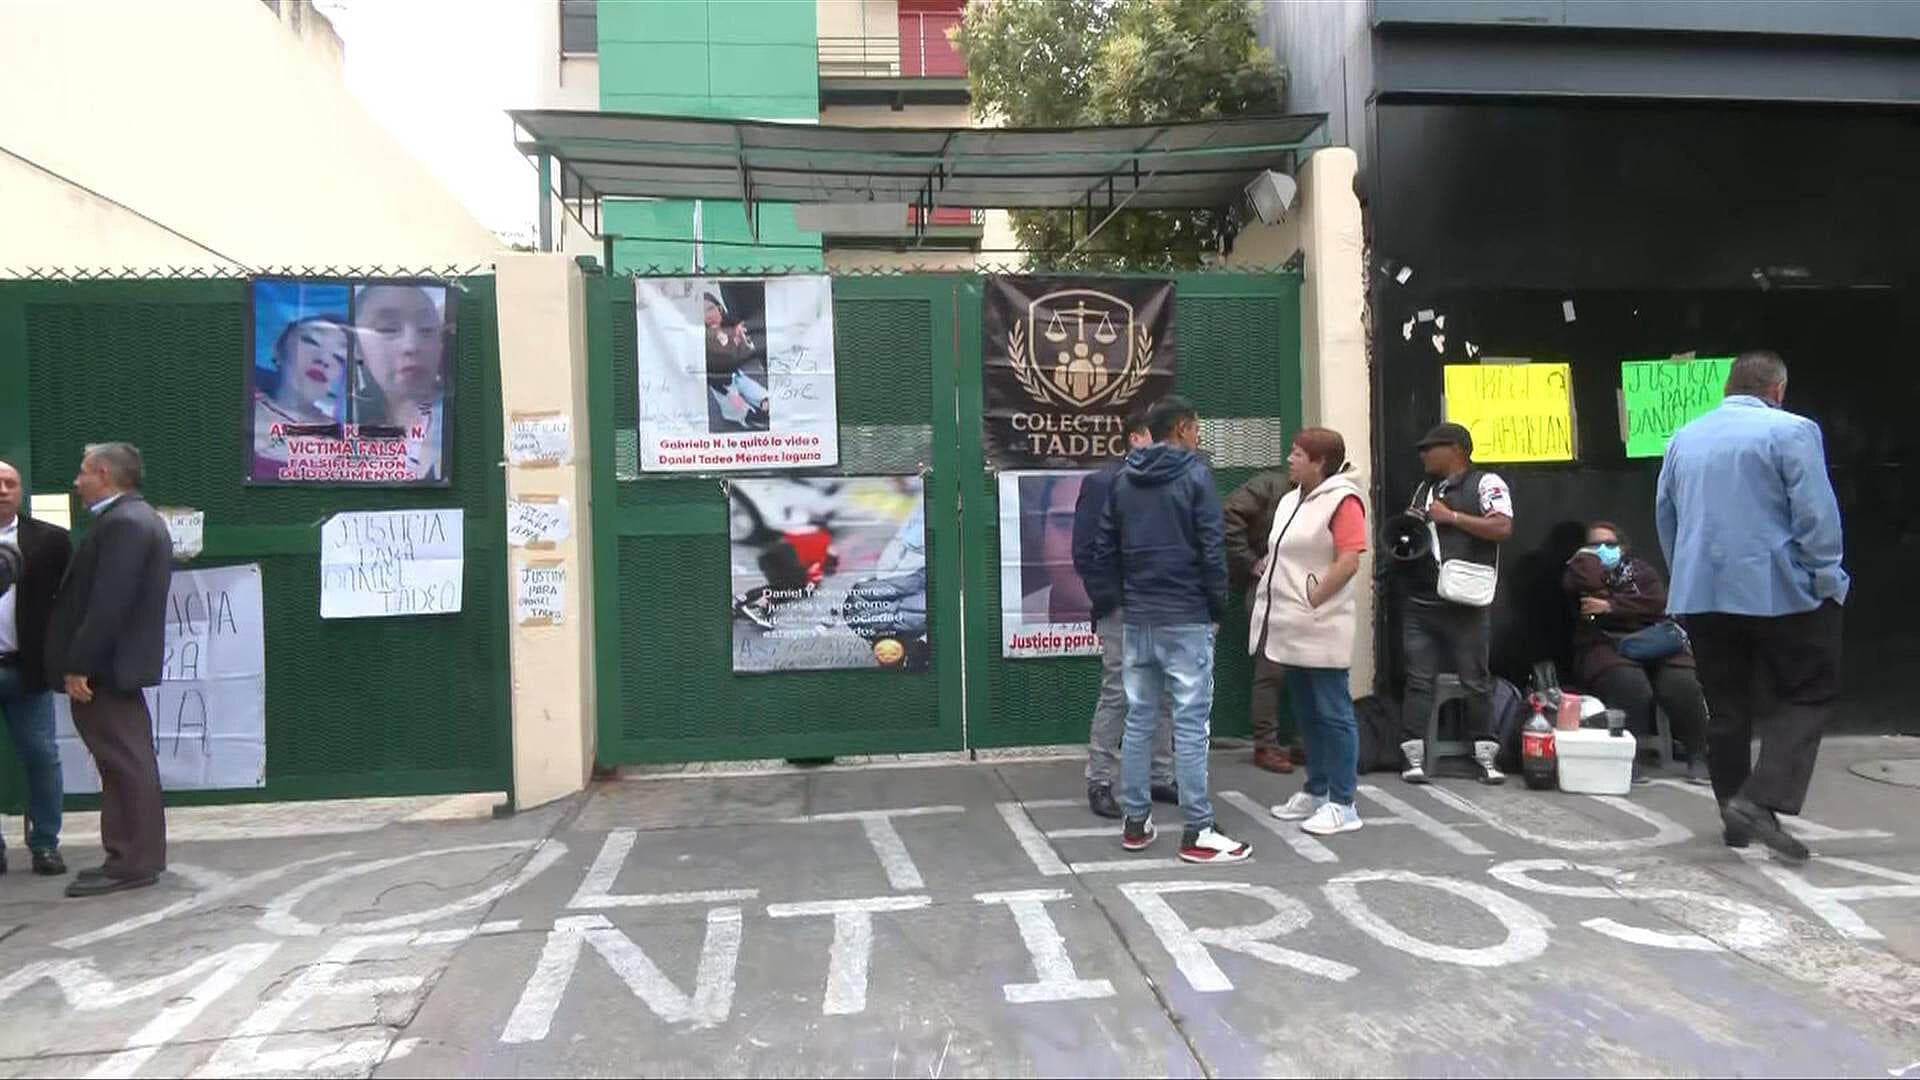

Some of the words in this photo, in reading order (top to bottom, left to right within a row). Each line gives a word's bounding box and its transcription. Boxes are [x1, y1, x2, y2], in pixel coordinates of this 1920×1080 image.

[1628, 361, 1720, 392] JUSTICIA
[1661, 386, 1710, 411] PARA
[1011, 413, 1122, 432] COLECTIV
[412, 425, 425, 438] N.
[288, 441, 353, 455] VICTIMA
[358, 440, 407, 456] FALSA
[659, 438, 710, 449] Gabriela
[713, 438, 725, 449] N.
[727, 438, 738, 448] le
[740, 436, 769, 450] quitó
[771, 436, 782, 446] la
[785, 434, 809, 446] vida
[659, 454, 696, 465] Daniel
[699, 454, 734, 464] Tadeo
[781, 451, 821, 463] laguna
[333, 512, 446, 548] JUSTICIA
[763, 588, 802, 598] Daniel
[855, 601, 889, 610] como
[172, 591, 238, 638] ICIA
[1009, 631, 1061, 649] Justicia
[1064, 633, 1094, 652] para
